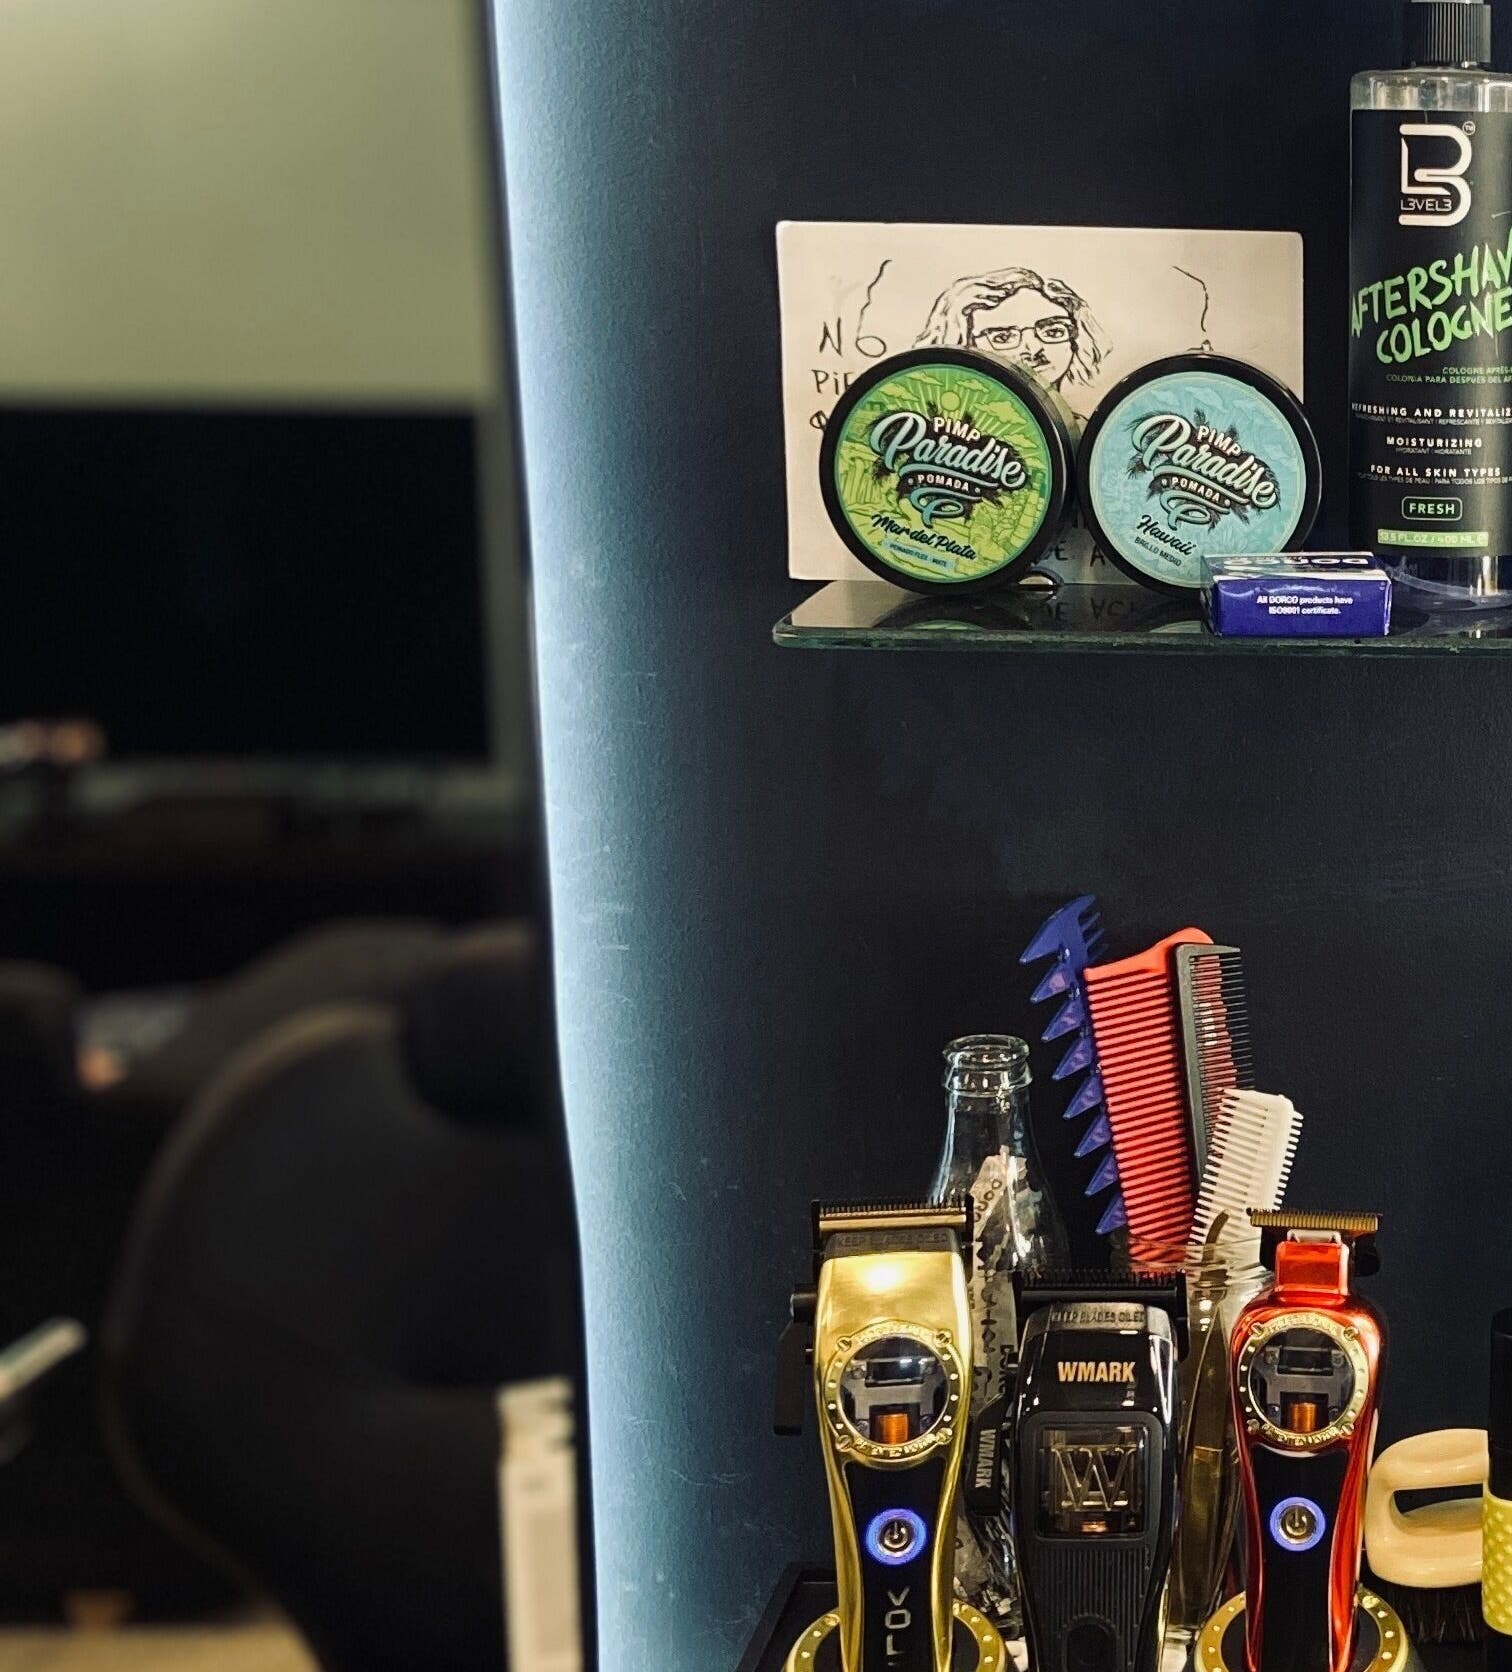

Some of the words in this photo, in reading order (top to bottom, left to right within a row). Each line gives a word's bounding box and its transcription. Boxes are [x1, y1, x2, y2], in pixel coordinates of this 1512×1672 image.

[1414, 408, 1443, 418] AND
[933, 416, 981, 442] PIMP
[1196, 425, 1242, 457] PIMP
[870, 411, 1026, 488] Paradise
[1386, 436, 1482, 448] MOISTURIZING
[1132, 414, 1277, 509] Paradise
[1370, 464, 1391, 475] FOR
[1397, 467, 1419, 477] ALL
[1425, 467, 1457, 478] SKIN
[1464, 466, 1501, 478] TYPES
[917, 474, 969, 491] POMADA
[1171, 476, 1220, 502] POMADA
[1409, 503, 1455, 515] FRESH
[871, 514, 911, 538] Mar
[909, 527, 937, 547] del
[935, 535, 978, 561] Plata
[1136, 515, 1197, 555] Hawaii
[1160, 550, 1182, 567] MEDIO
[1257, 595, 1268, 604] All
[1268, 595, 1299, 605] DORCO
[1299, 595, 1334, 606] products
[1334, 596, 1354, 605] have
[1058, 1361, 1136, 1383] WMARK
[975, 1429, 997, 1488] WMARK
